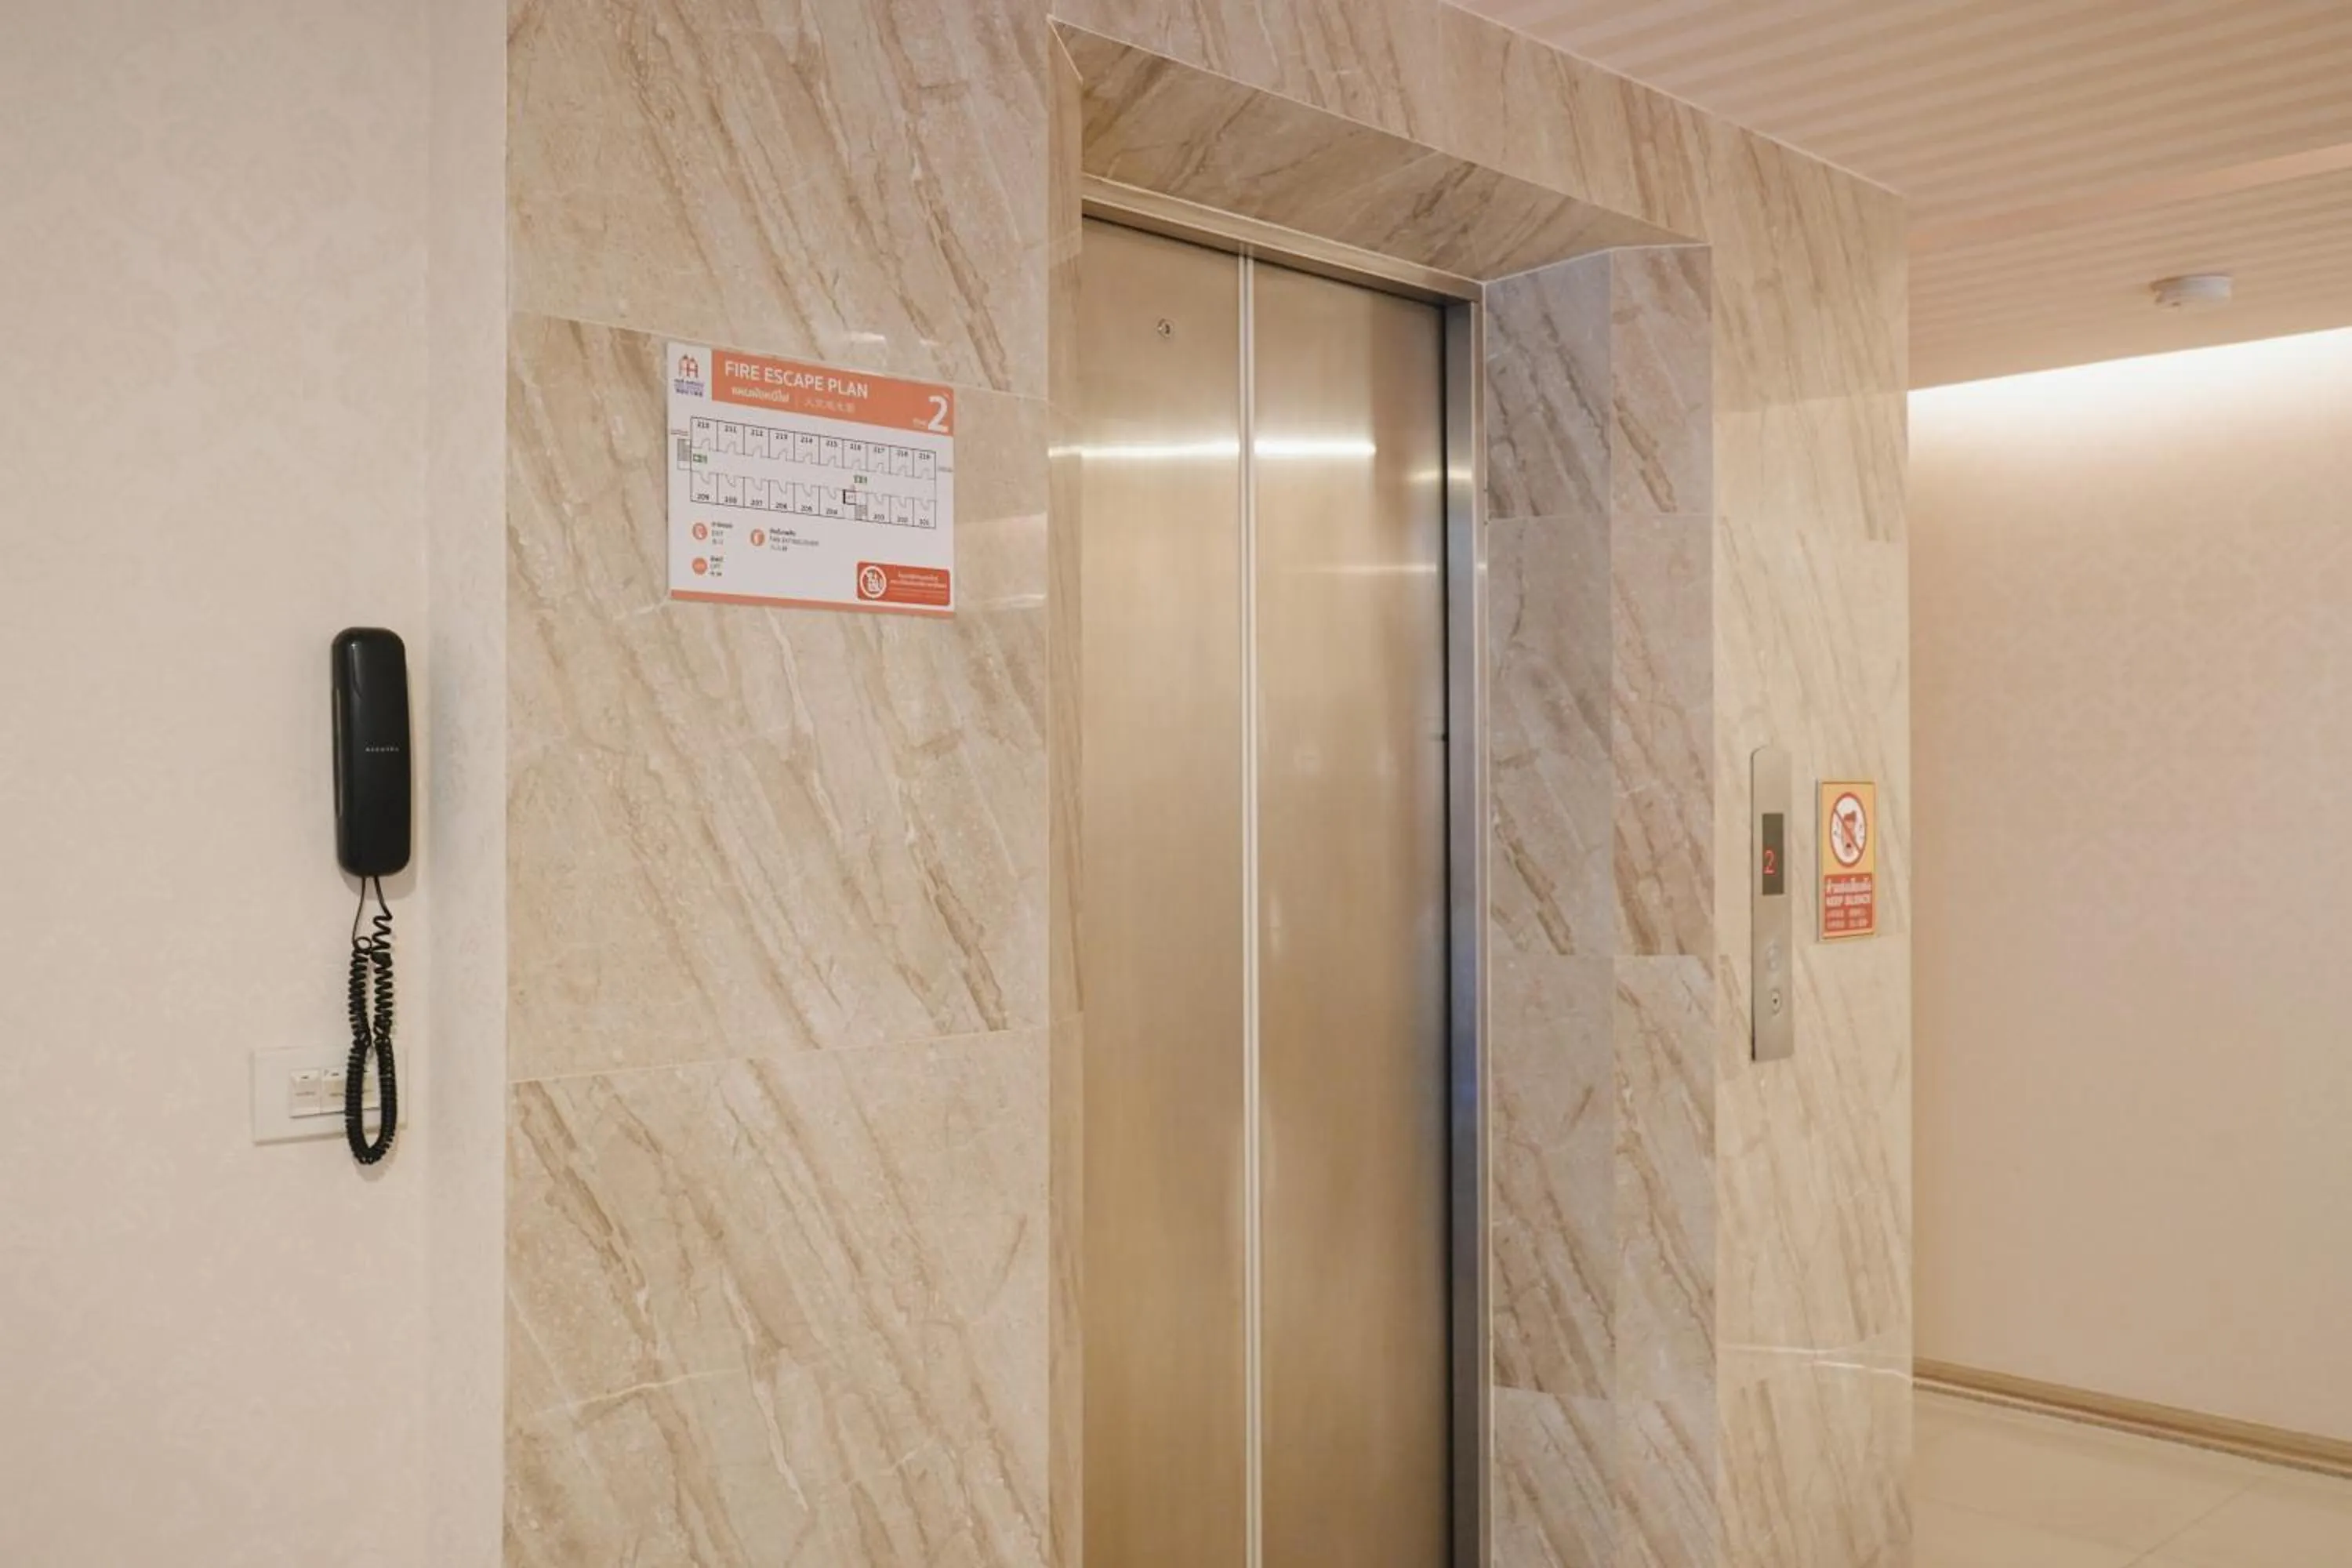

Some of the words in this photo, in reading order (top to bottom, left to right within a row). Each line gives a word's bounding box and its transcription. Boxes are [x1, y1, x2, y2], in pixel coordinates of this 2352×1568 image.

[725, 361, 760, 380] FIRE
[764, 368, 824, 391] ESCAPE
[827, 380, 868, 398] PLAN
[928, 395, 949, 433] 2
[1763, 849, 1777, 874] 2
